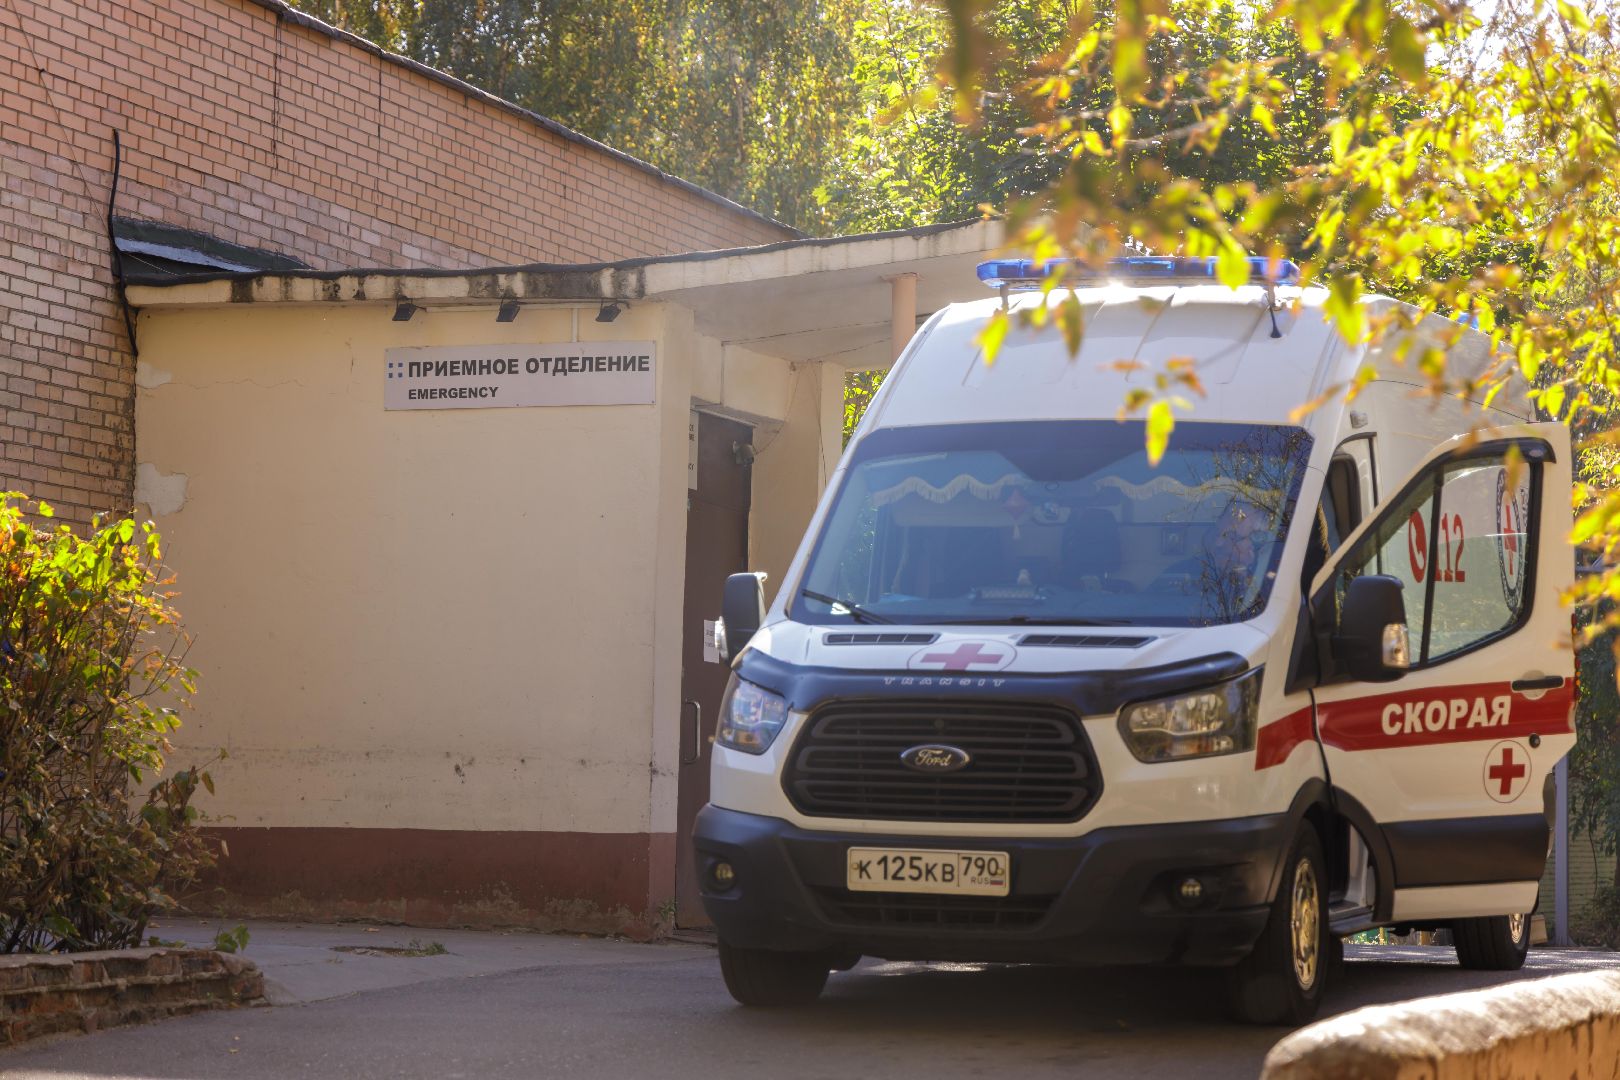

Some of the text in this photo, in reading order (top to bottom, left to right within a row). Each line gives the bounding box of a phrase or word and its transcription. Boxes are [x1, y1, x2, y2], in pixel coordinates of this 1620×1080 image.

[408, 355, 650, 378] ПРИЕМНОЕ ОТДЕЛЕНИЕ
[408, 386, 499, 400] EMERGENCY
[1434, 513, 1465, 582] 12
[883, 676, 1006, 687] TRANSIT
[1381, 695, 1512, 736] СКОРАЯ
[914, 748, 951, 767] Ford
[961, 856, 1000, 877] 790
[970, 876, 990, 885] RUS
